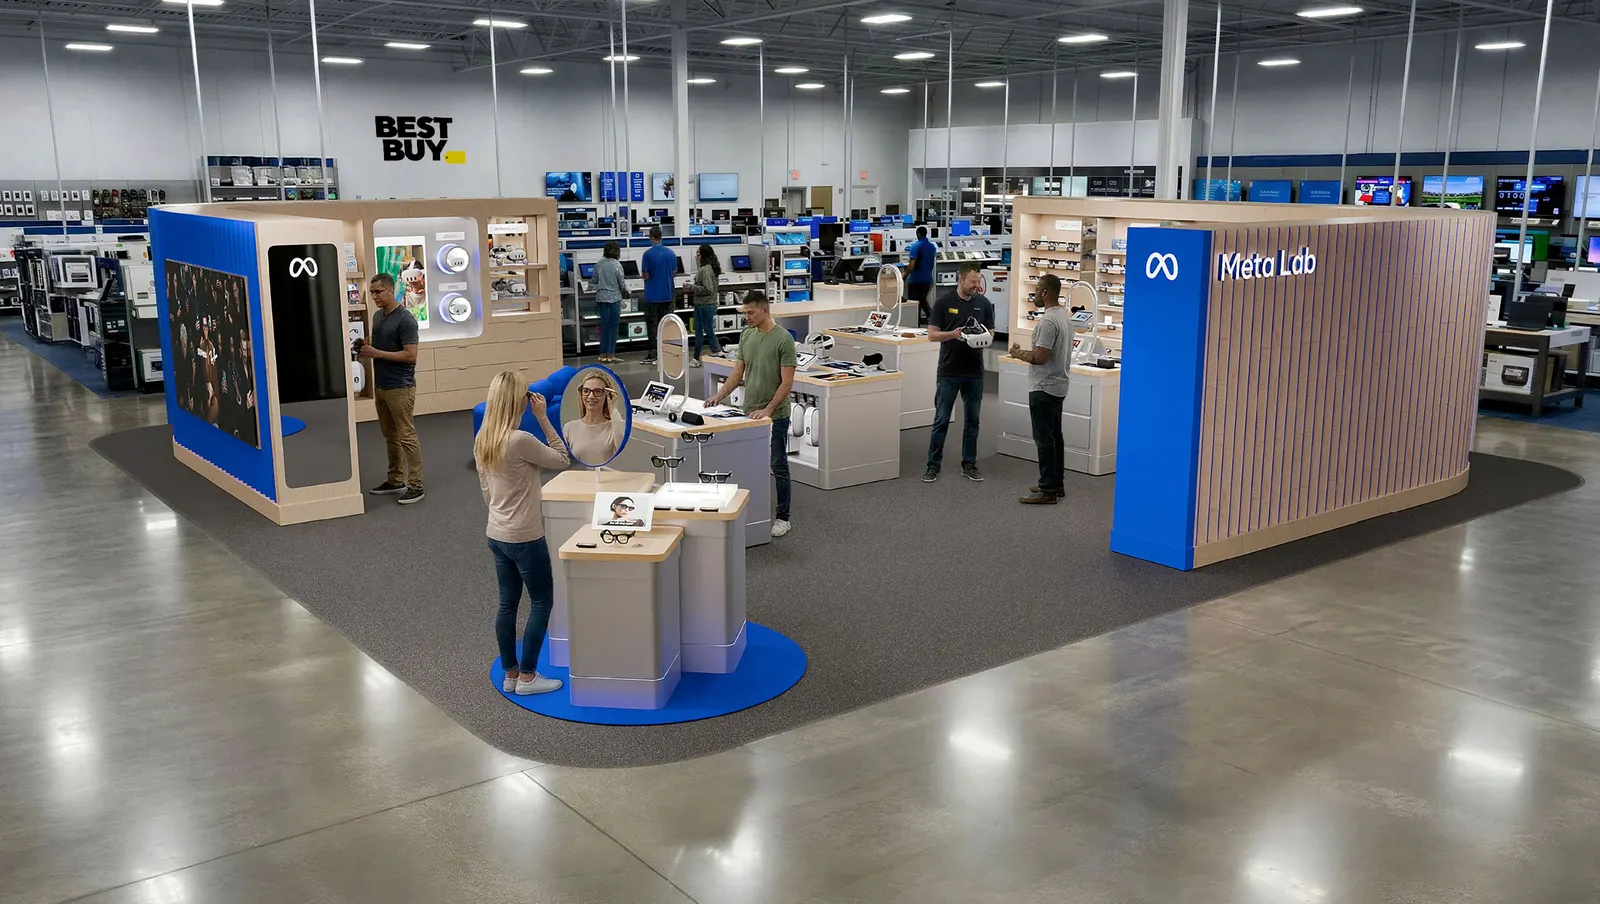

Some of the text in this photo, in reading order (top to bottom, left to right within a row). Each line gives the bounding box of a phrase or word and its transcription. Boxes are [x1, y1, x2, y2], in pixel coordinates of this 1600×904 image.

[375, 116, 453, 139] BEST
[382, 139, 448, 161] BUY
[1219, 247, 1316, 281] Meta Lab
